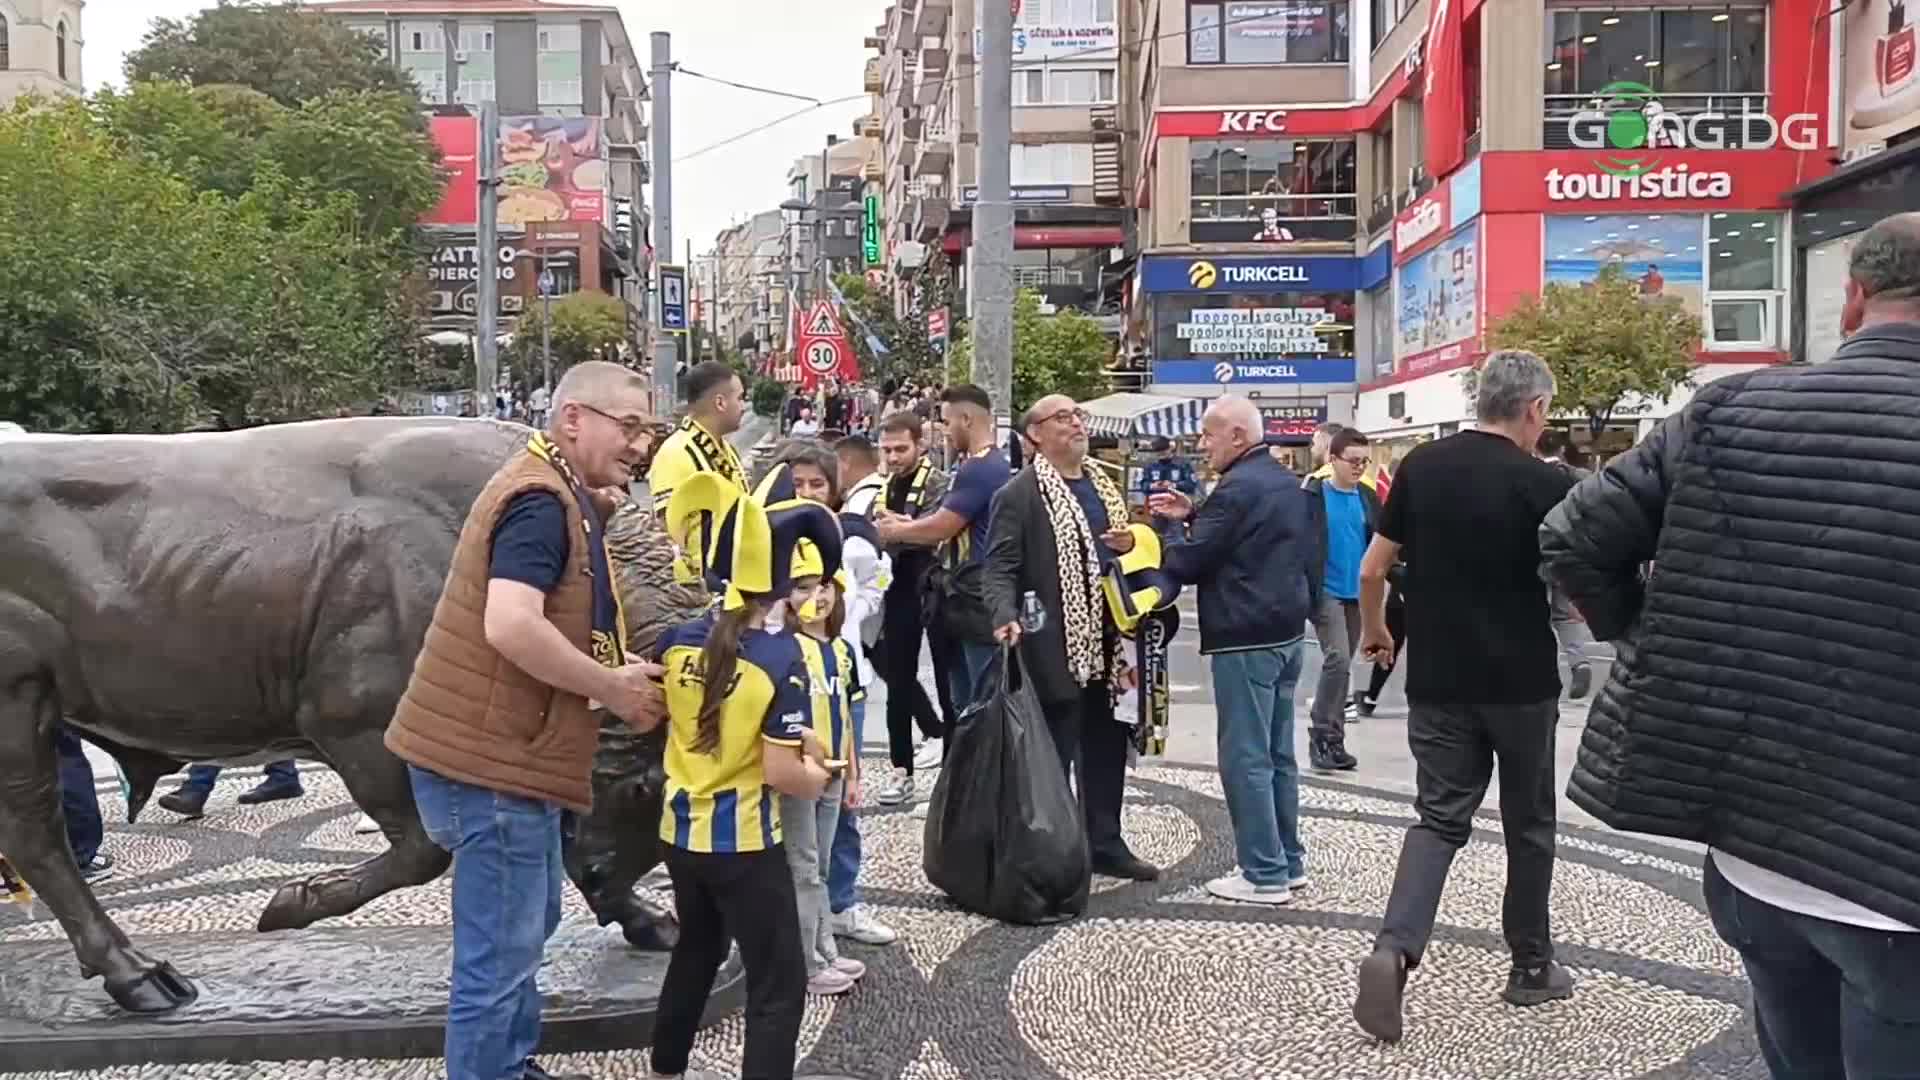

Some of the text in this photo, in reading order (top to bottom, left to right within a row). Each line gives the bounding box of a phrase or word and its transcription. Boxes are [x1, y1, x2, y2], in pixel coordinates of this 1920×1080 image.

[1218, 111, 1287, 132] KFC
[1544, 163, 1731, 200] touristica
[431, 246, 516, 263] TATTO
[1221, 265, 1310, 283] TURKCELL
[811, 347, 833, 364] 30
[1236, 365, 1297, 377] TURKCELL
